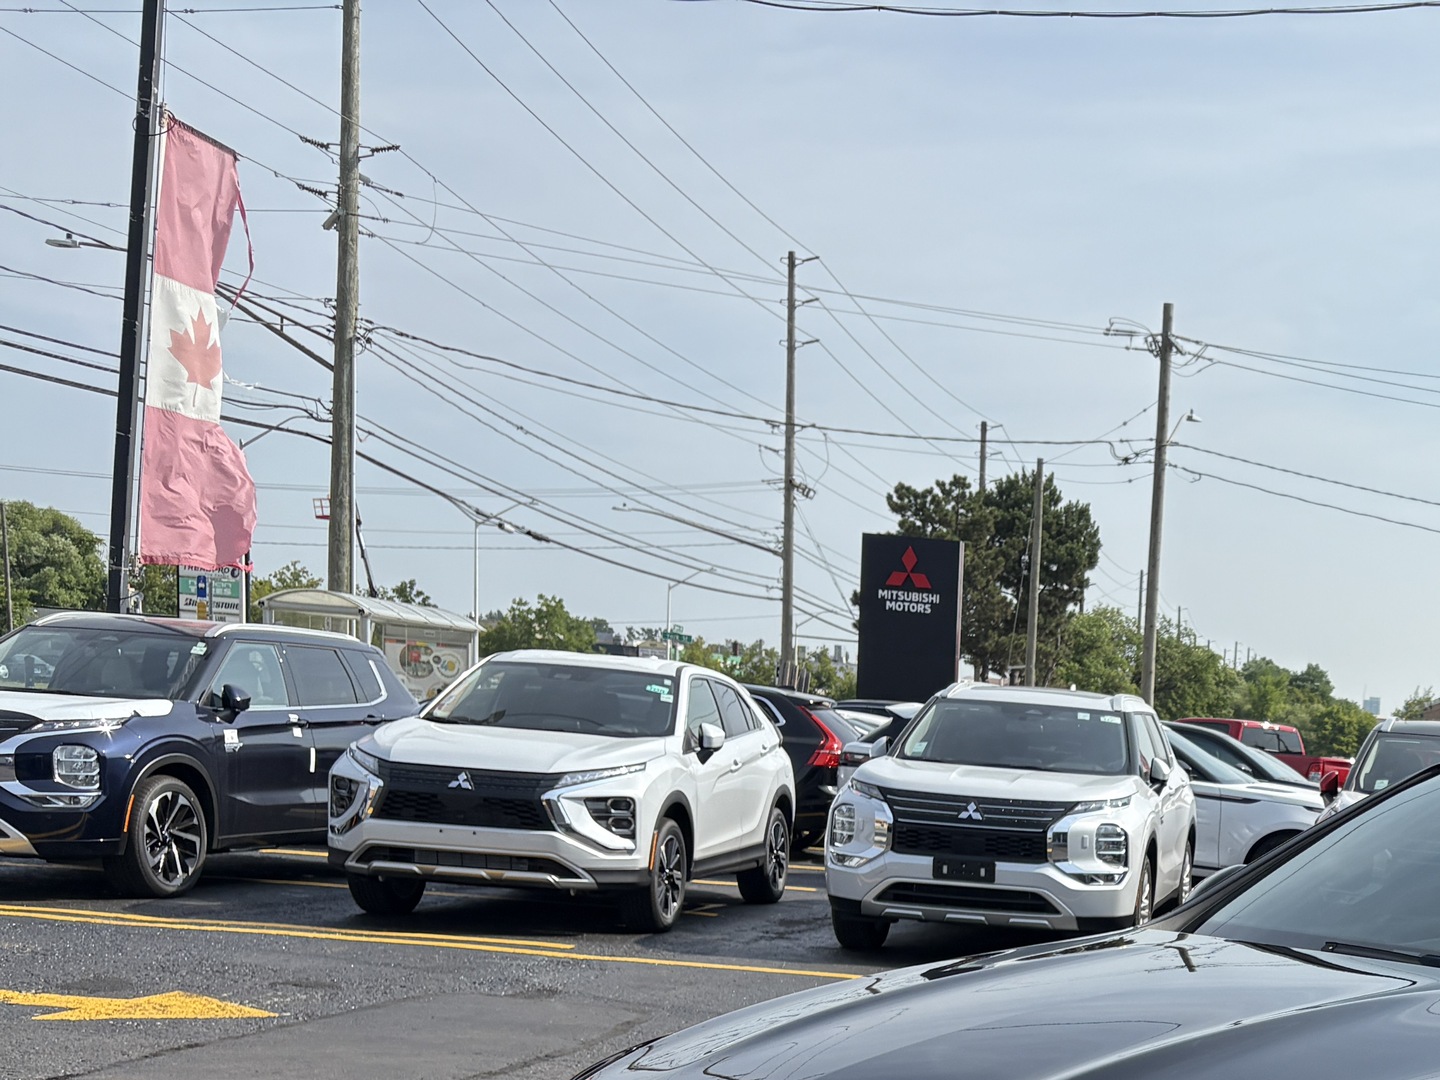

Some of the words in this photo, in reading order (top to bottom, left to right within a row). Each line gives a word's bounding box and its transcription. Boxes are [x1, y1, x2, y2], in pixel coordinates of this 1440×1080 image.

[878, 588, 940, 604] MITSUBISHI
[184, 598, 240, 610] BRSTONE
[885, 600, 932, 614] MOTORS
